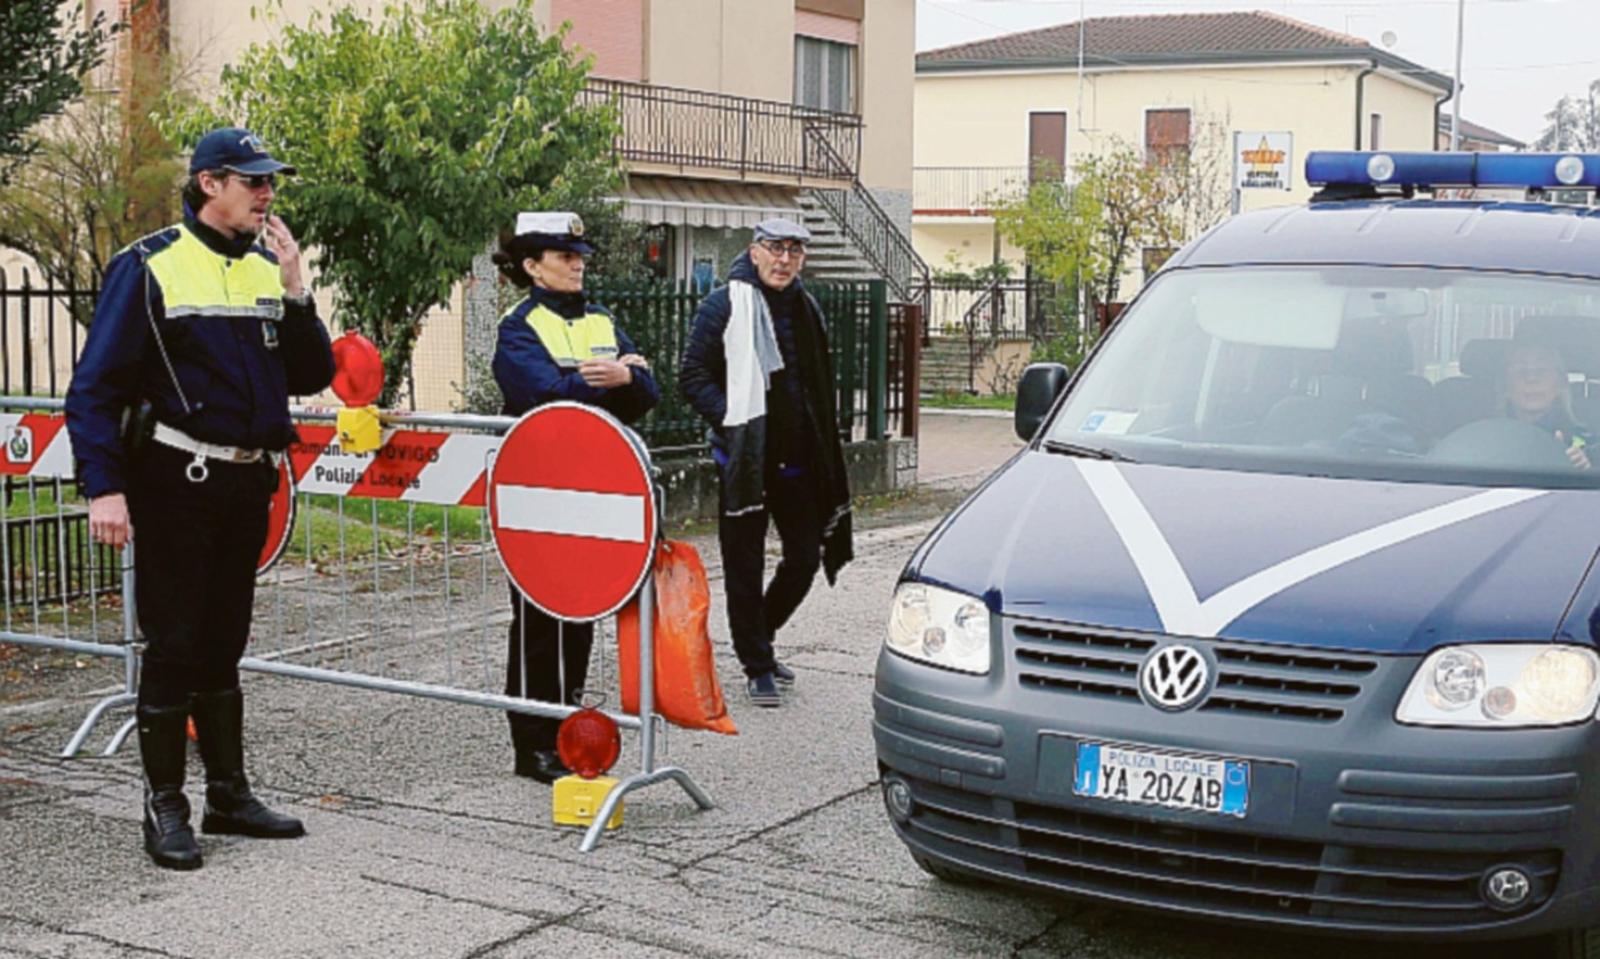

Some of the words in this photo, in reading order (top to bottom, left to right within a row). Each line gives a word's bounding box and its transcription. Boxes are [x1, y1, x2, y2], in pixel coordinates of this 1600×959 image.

[315, 465, 363, 484] Polizia
[370, 472, 421, 489] Locale
[1109, 751, 1156, 769] POLIZIA
[1164, 758, 1218, 777] LOCALE
[1102, 765, 1129, 797] YA
